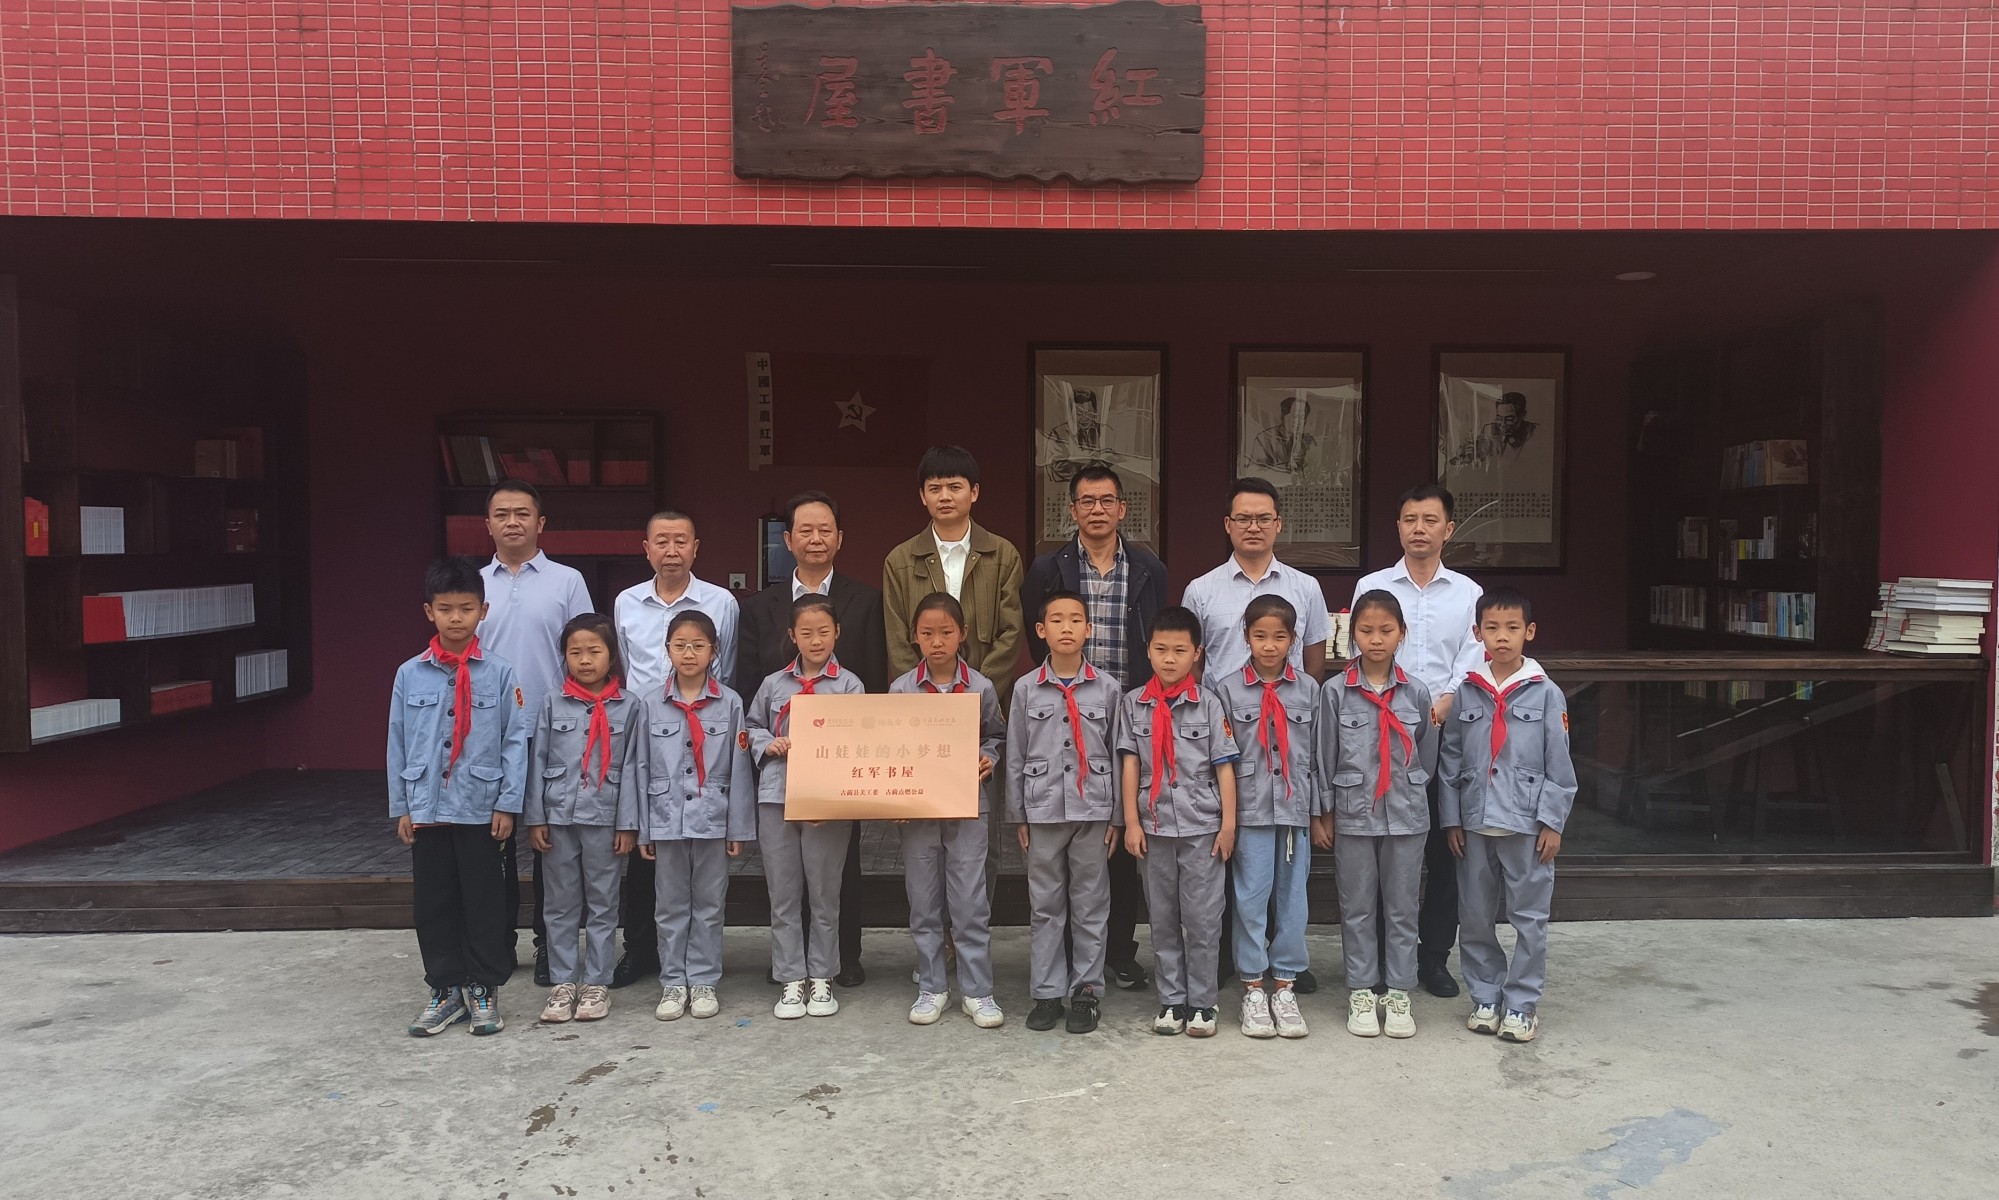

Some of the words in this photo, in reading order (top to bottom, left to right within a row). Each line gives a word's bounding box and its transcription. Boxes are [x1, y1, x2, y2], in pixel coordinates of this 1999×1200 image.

[815, 744, 952, 760] 山娃娃的小梦想
[851, 766, 914, 779] 红军书屋
